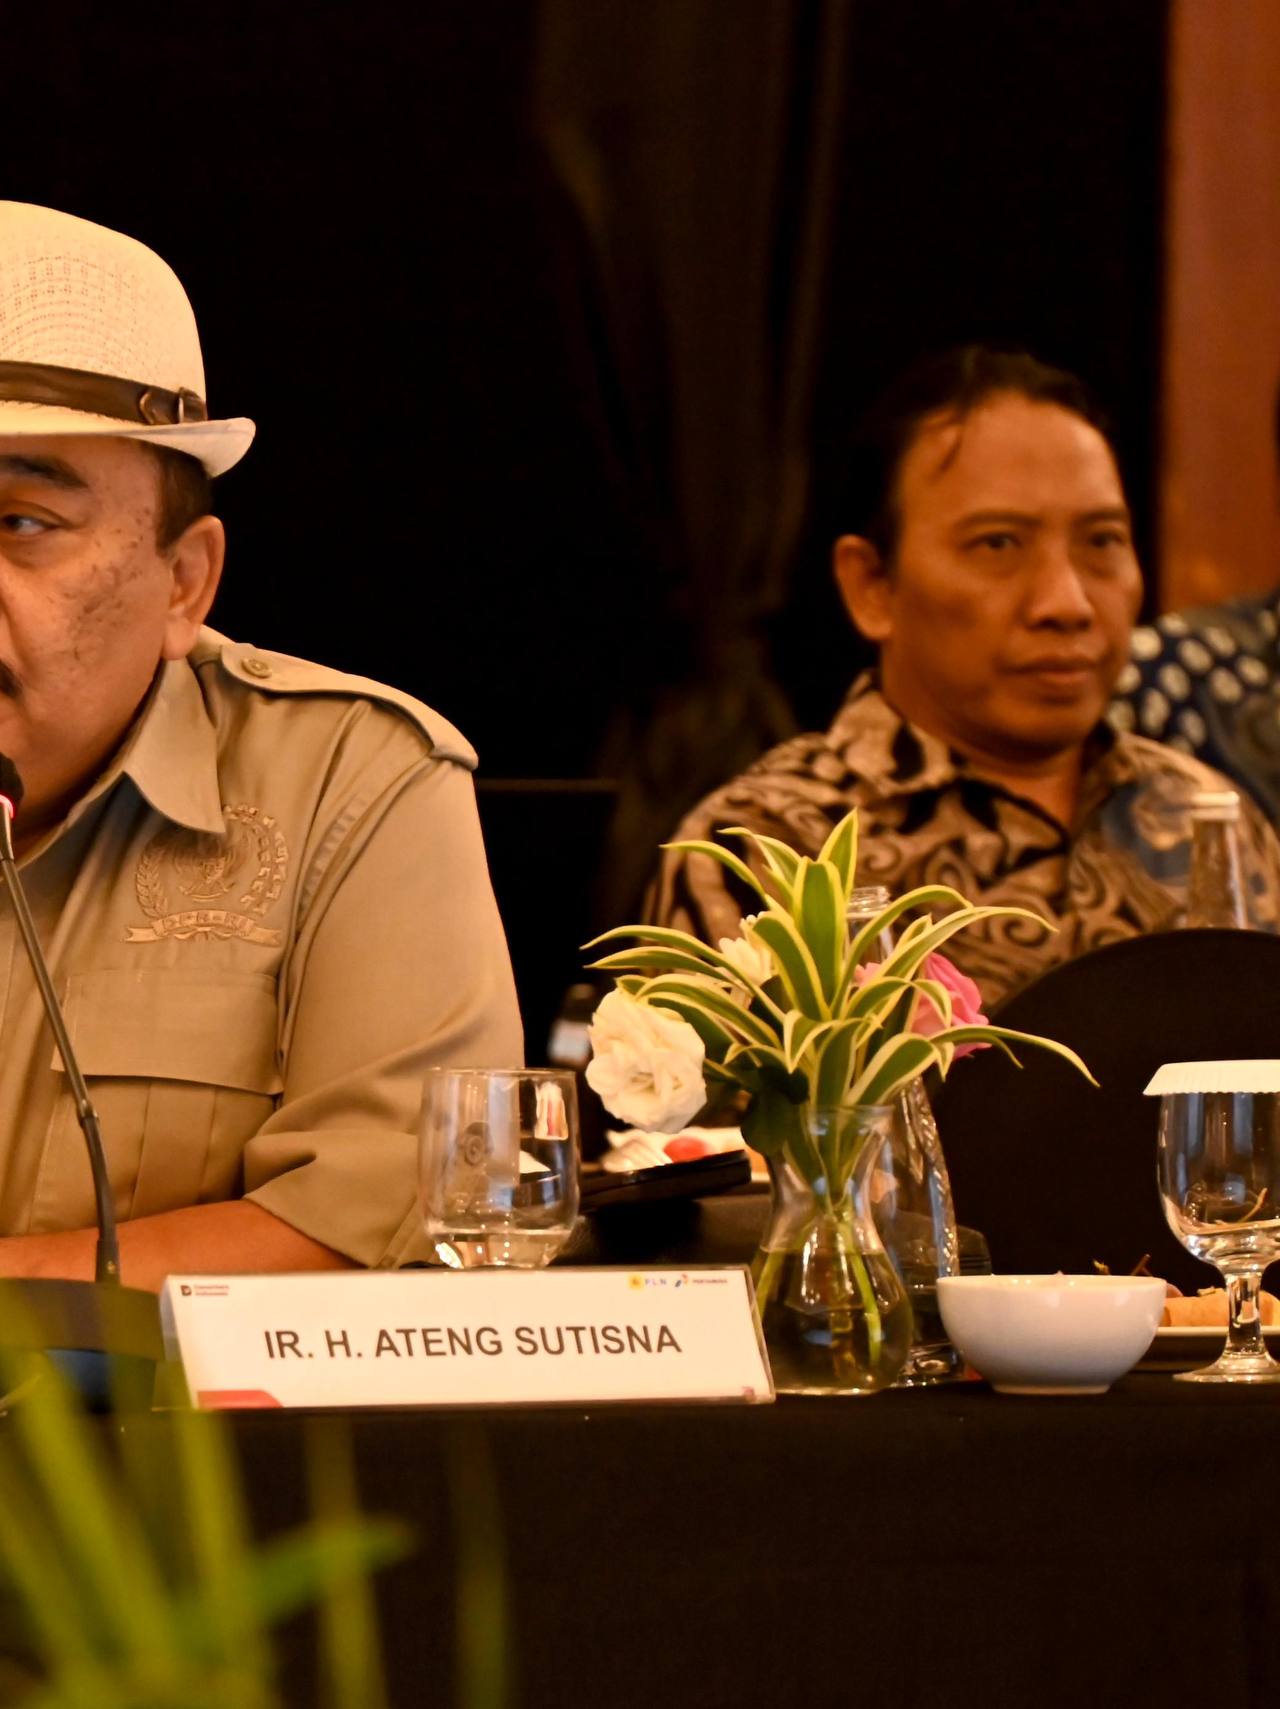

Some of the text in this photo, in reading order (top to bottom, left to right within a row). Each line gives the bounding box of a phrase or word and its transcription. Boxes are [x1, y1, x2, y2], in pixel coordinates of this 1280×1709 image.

[264, 1324, 683, 1359] IR. H. ATENG SUTISNA
